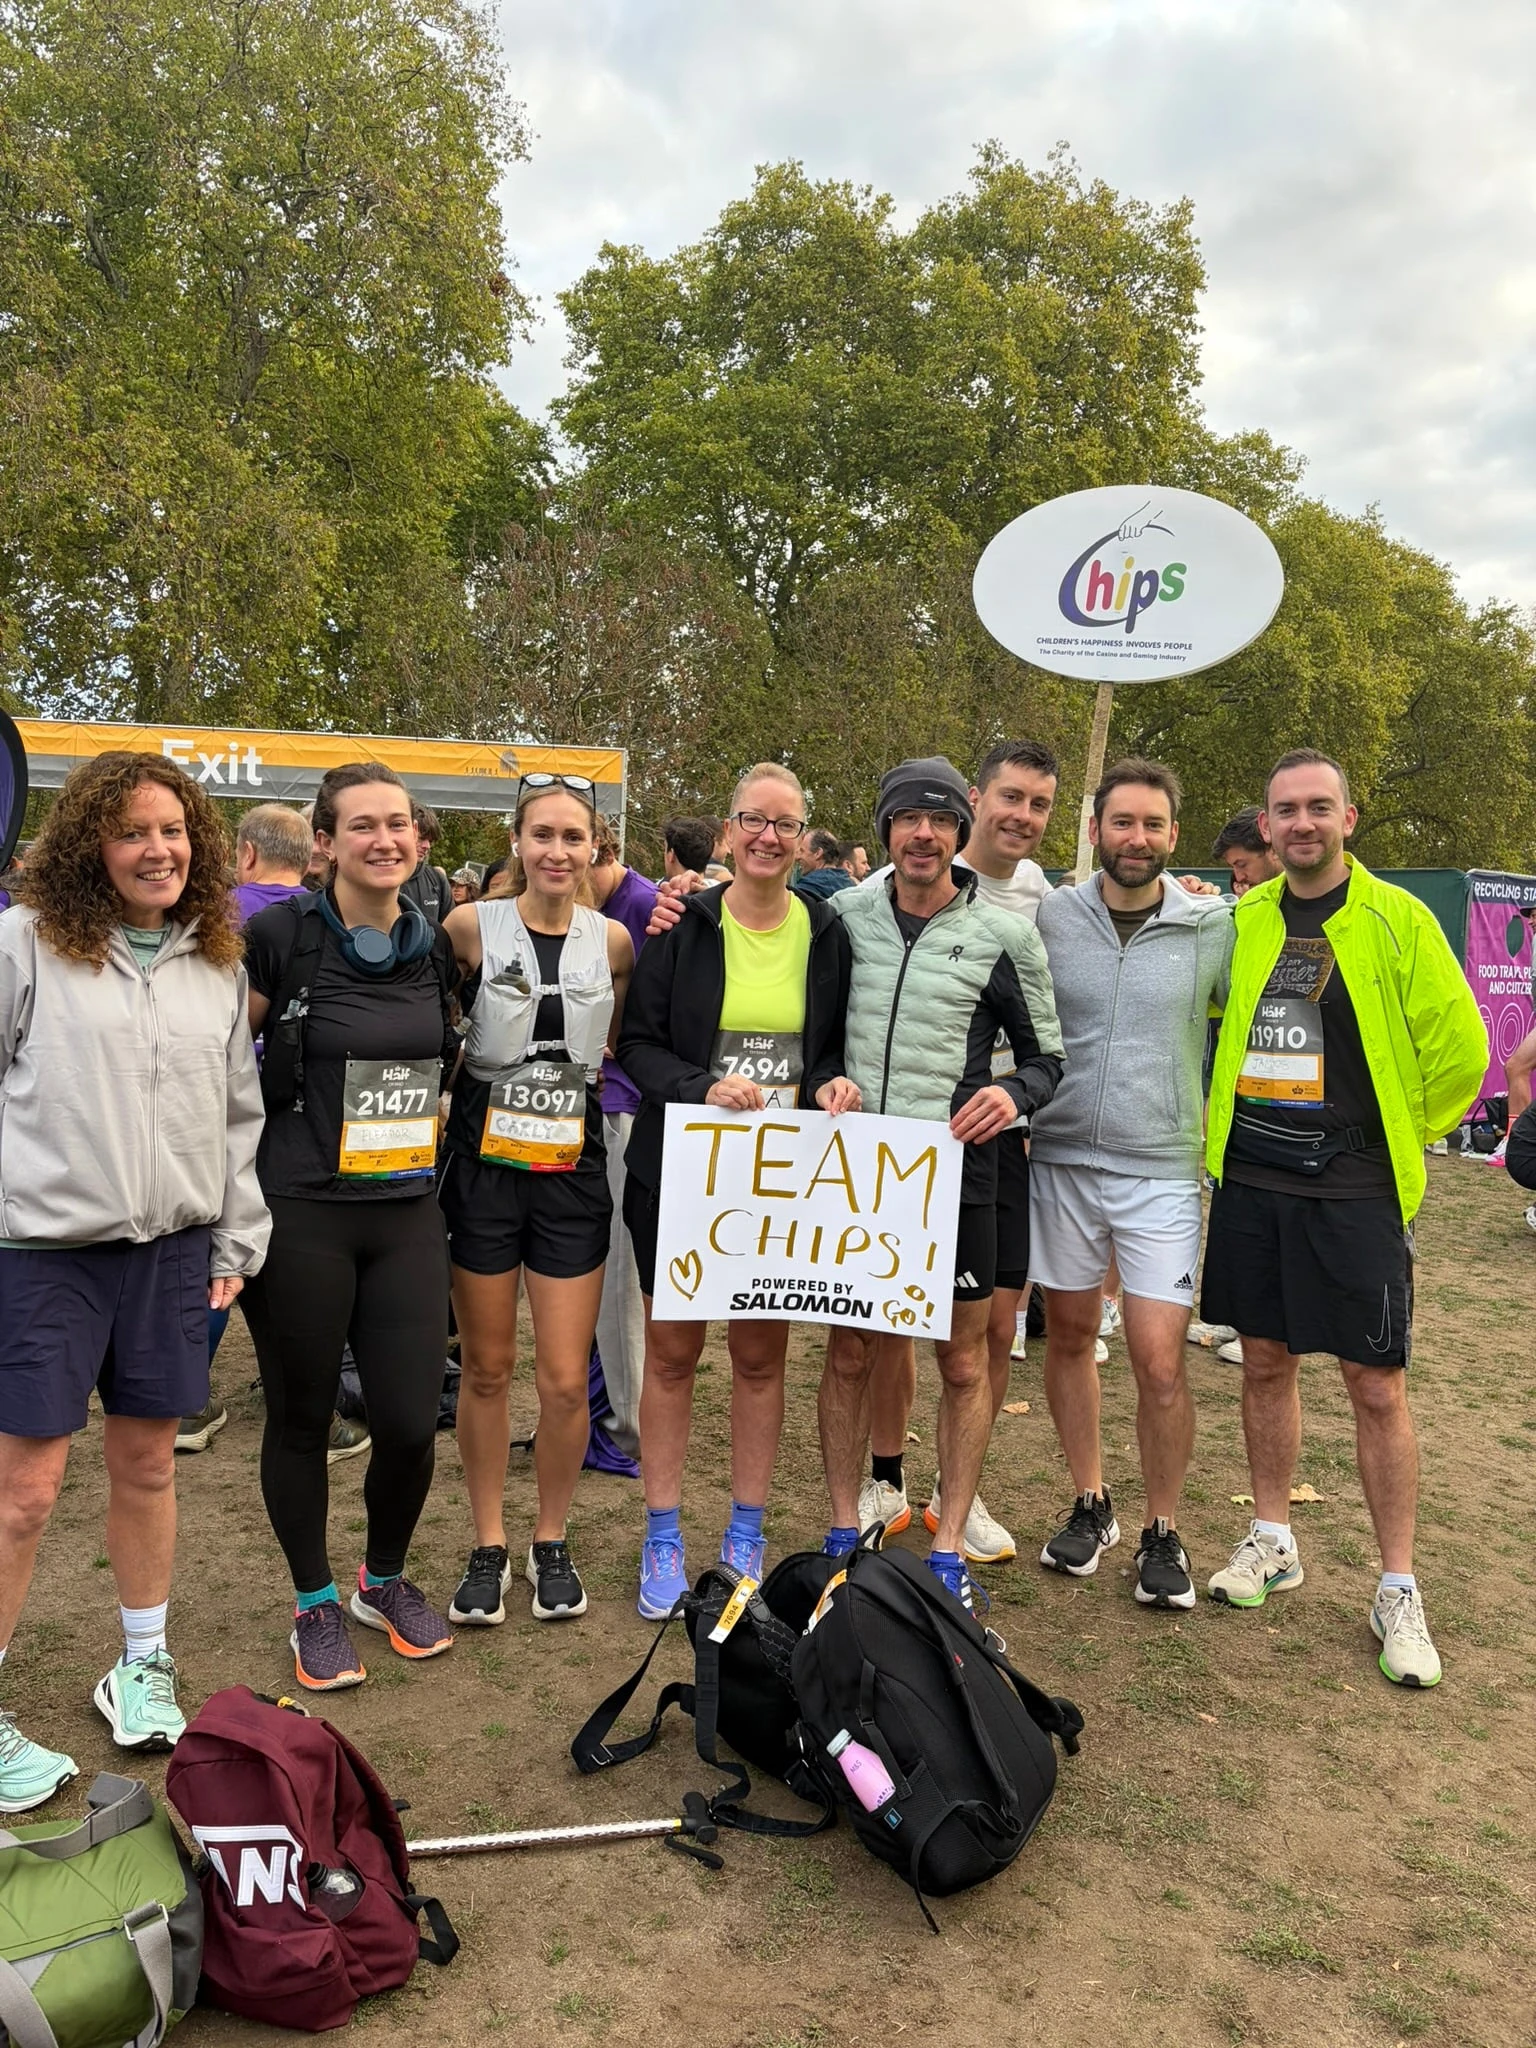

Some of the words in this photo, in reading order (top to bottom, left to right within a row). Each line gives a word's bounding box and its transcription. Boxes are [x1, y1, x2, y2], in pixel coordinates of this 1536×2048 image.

[1036, 637, 1079, 646] CHILDREN'S
[1081, 639, 1123, 648] HAPPINESS
[1125, 641, 1162, 649] INVOLVES
[1163, 642, 1193, 651] PEOPLE
[1052, 649, 1075, 657] Charity
[1096, 650, 1118, 658] Casino
[1119, 651, 1132, 659] and
[1133, 652, 1158, 660] Gaming
[1159, 653, 1187, 662] Industry
[162, 738, 263, 786] Exit
[1474, 881, 1521, 900] RECYCLING
[1478, 964, 1499, 978] FOOD
[1489, 981, 1505, 995] AND
[1506, 981, 1533, 995] CUTLER
[1261, 1005, 1287, 1018] Half
[742, 1037, 775, 1050] Half
[1250, 1024, 1307, 1050] 11910
[382, 1066, 411, 1081] Half
[532, 1067, 562, 1082] Half
[722, 1056, 790, 1081] 7694
[357, 1088, 429, 1116] 21477
[502, 1083, 578, 1112] 13097
[684, 1122, 938, 1230] TEAM
[709, 1208, 938, 1300] CHIPS!
[751, 1278, 828, 1293] POWERED
[833, 1283, 855, 1295] BY
[729, 1292, 874, 1320] SALOMON
[723, 1604, 739, 1626] 7694
